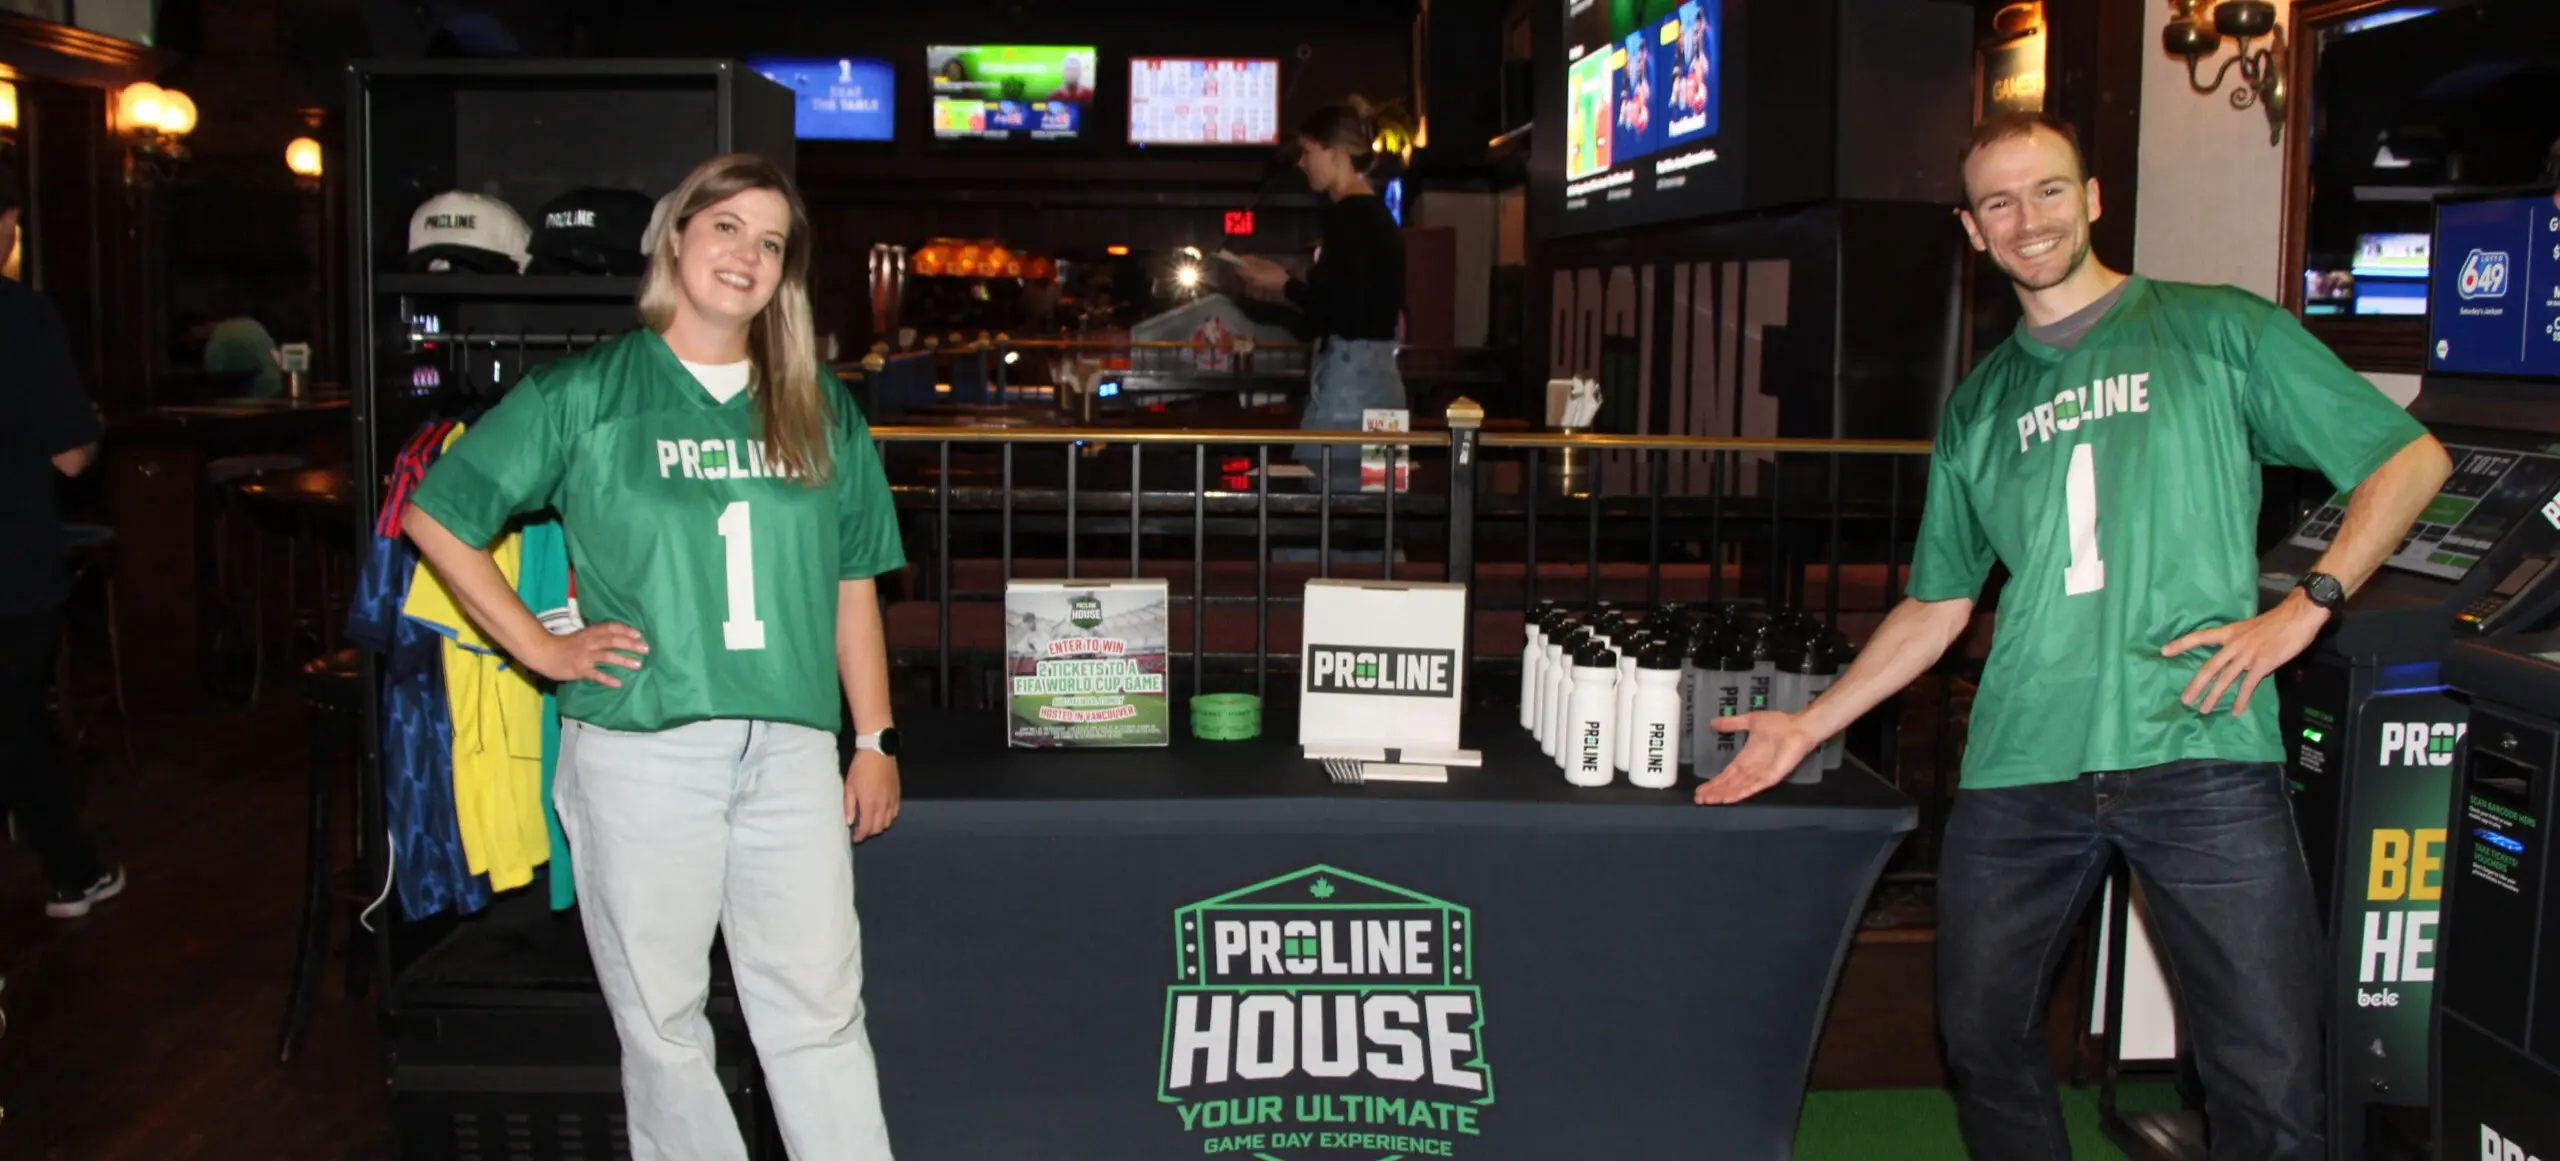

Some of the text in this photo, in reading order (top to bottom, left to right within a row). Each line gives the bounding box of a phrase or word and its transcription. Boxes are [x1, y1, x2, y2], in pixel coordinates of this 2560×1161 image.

[424, 214, 477, 230] PROLINE
[546, 209, 597, 229] PROLINE
[2017, 371, 2149, 454] PROLINE
[2064, 443, 2104, 597] 1
[717, 500, 766, 651] 1
[1071, 609, 1101, 620] HOUSE
[1049, 639, 1125, 655] ENTER TO WIN
[1016, 676, 1161, 693] FIFA WORLD CUP GAME
[1039, 660, 1138, 677] 2 TICKETS TO A
[1313, 650, 1449, 692] PROLINE
[1041, 705, 1135, 721] HOSTED IN VANCOUVER
[1582, 721, 1601, 772] PROLINE
[1647, 722, 1666, 774] PROLINE
[1214, 920, 1434, 975] PROLINE
[1169, 995, 1483, 1092] HOUSE
[1177, 1095, 1480, 1136] YOUR ULTIMATE
[1204, 1132, 1454, 1157] GAME DAY EXPERIENCE
